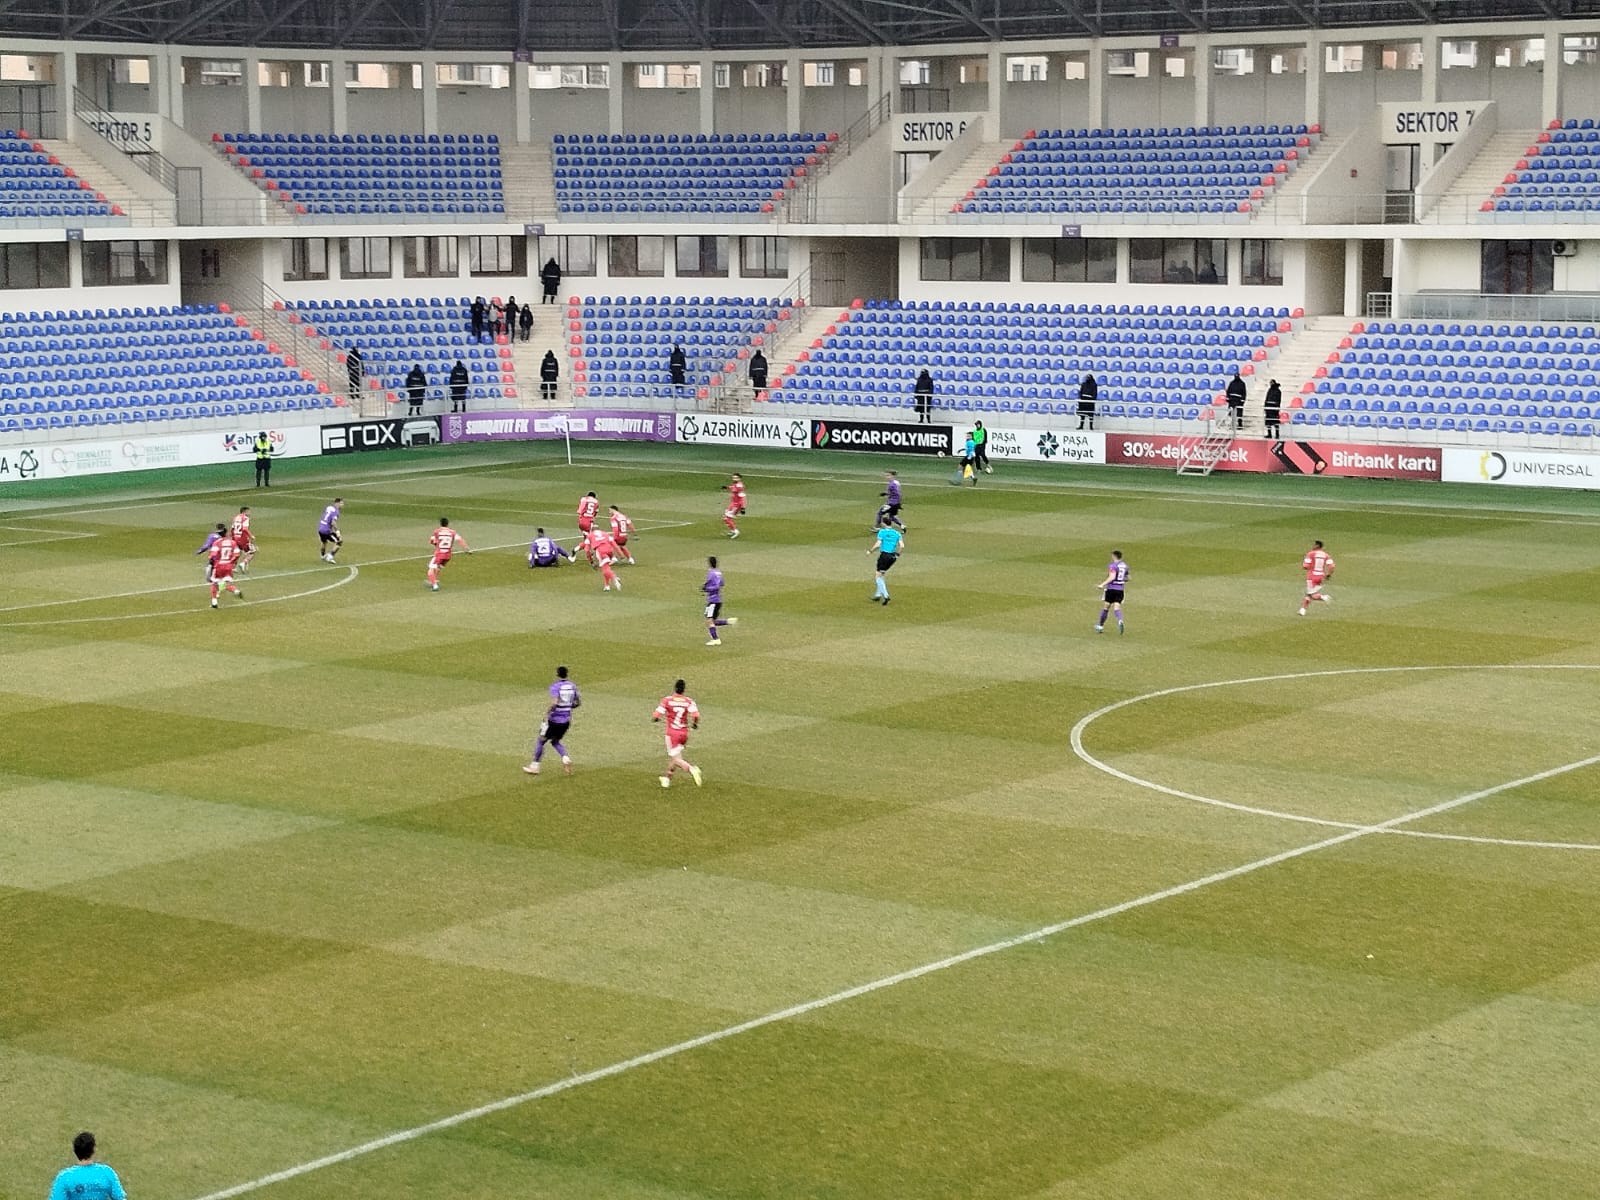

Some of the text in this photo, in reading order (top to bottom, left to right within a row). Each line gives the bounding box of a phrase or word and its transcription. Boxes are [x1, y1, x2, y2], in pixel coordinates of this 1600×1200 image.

[1396, 112, 1459, 133] SEKTOR
[144, 122, 152, 141] 5
[903, 122, 954, 141] SEKTOR
[702, 419, 781, 440] AZƏRİKİMYA
[991, 432, 1017, 443] PAŞA
[1062, 435, 1089, 447] PAŞA
[991, 444, 1022, 456] Həyat
[1062, 448, 1094, 460] Həyat
[1332, 451, 1394, 471] Birbank
[1513, 461, 1593, 477] UNIVERSAL
